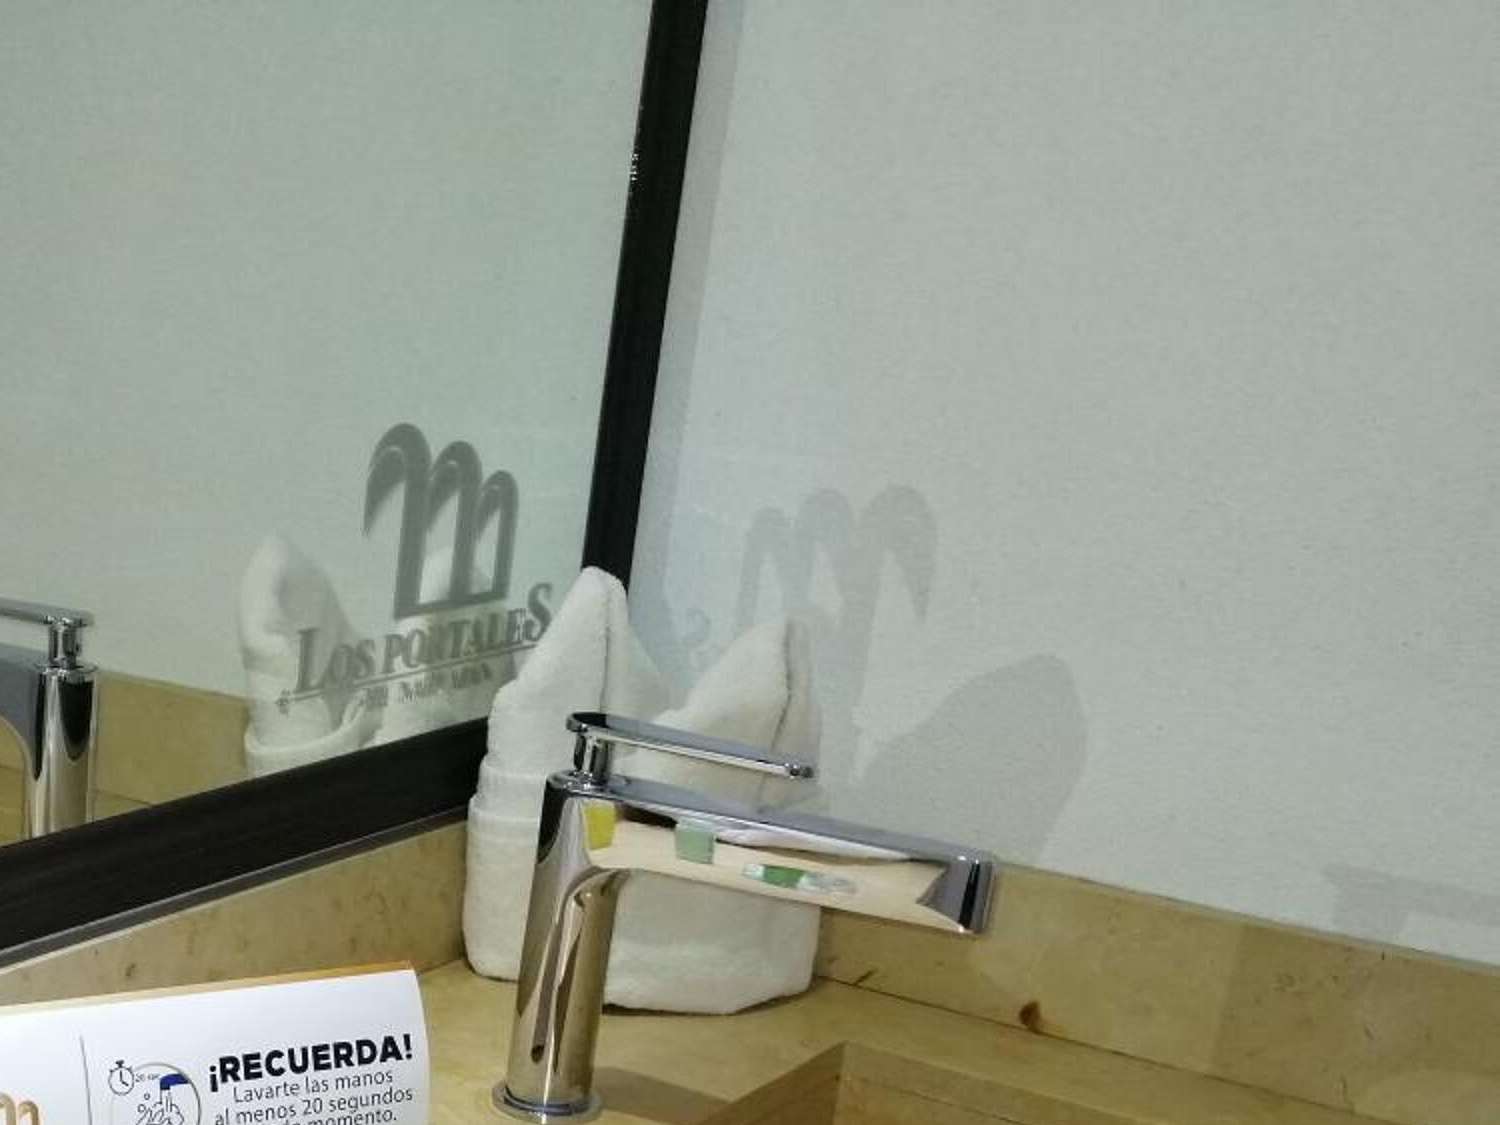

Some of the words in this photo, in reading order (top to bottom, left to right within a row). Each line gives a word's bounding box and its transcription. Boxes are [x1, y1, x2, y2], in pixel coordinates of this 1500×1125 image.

[209, 1033, 413, 1093] ¡RECUERDA!
[233, 1080, 301, 1103] Lavarte
[304, 1076, 329, 1094] las
[335, 1070, 393, 1091] manos
[236, 1104, 297, 1125] menos
[302, 1099, 324, 1116] 20
[329, 1087, 413, 1115] segundos
